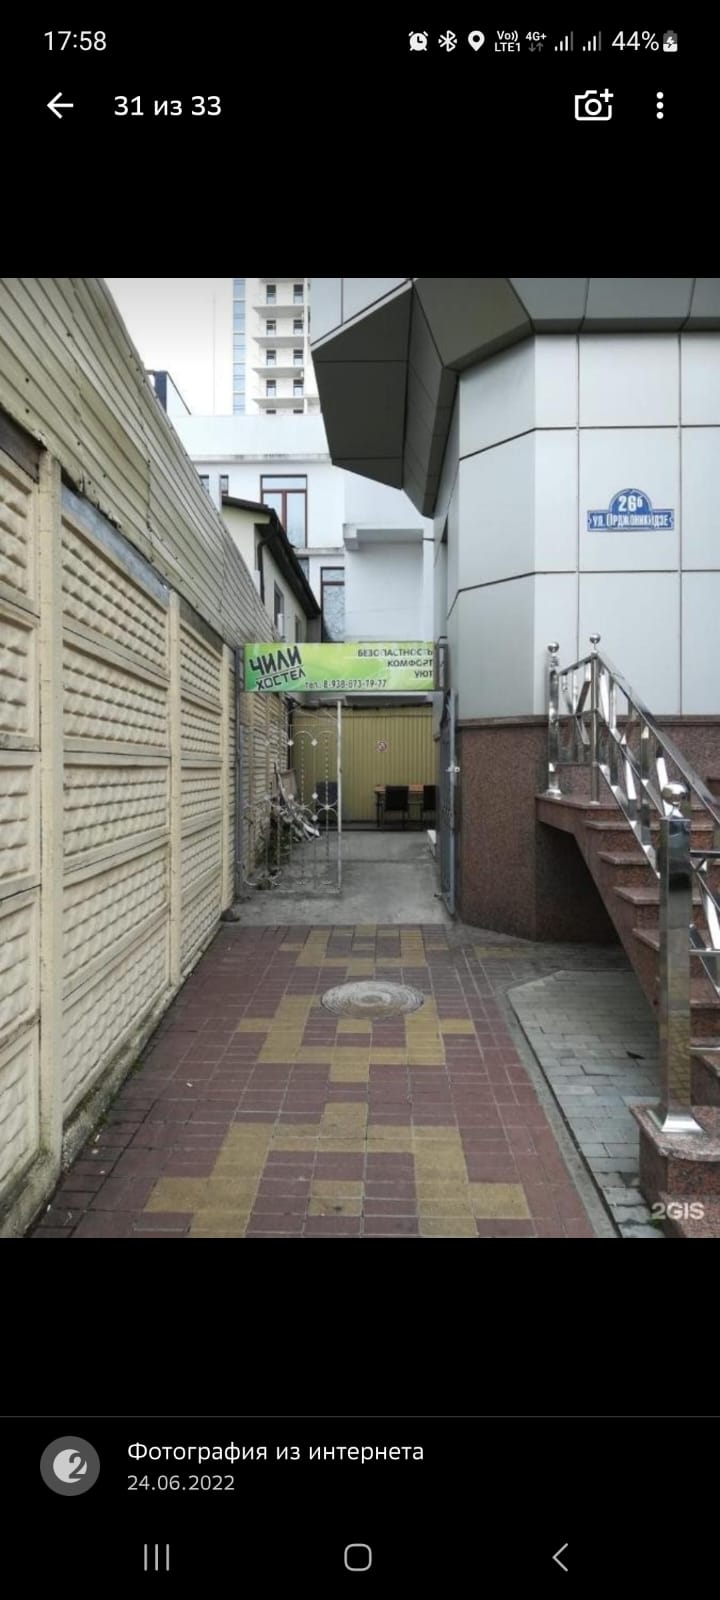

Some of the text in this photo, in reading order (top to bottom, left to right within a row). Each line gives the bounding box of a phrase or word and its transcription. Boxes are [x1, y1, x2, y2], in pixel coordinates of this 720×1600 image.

[250, 645, 302, 676] ЧИЛИ
[387, 659, 433, 667] КОМФОРТ
[256, 668, 306, 690] ХОСТЕЛ
[414, 670, 433, 678] УЮТ
